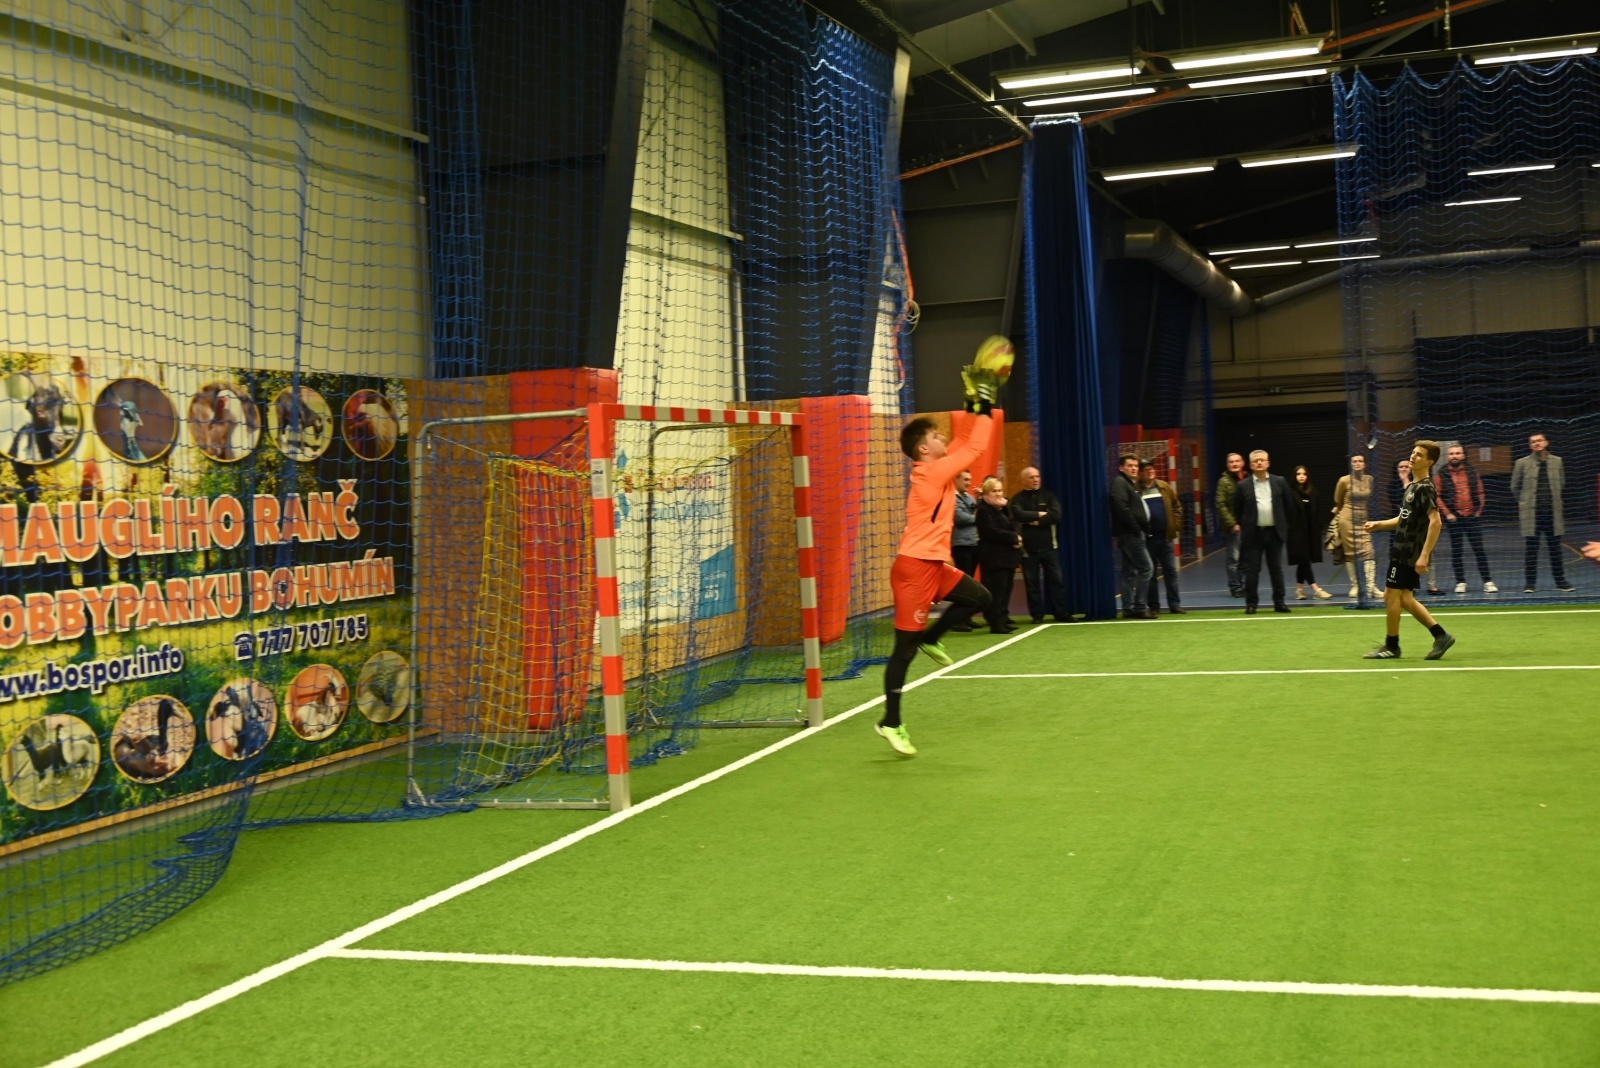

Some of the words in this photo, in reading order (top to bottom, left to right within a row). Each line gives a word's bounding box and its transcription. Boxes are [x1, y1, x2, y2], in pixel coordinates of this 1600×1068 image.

[253, 479, 360, 545] RANČ
[249, 549, 394, 613] BOHUMÍN
[257, 625, 294, 657] 777
[297, 619, 332, 650] 707
[334, 613, 367, 643] 785
